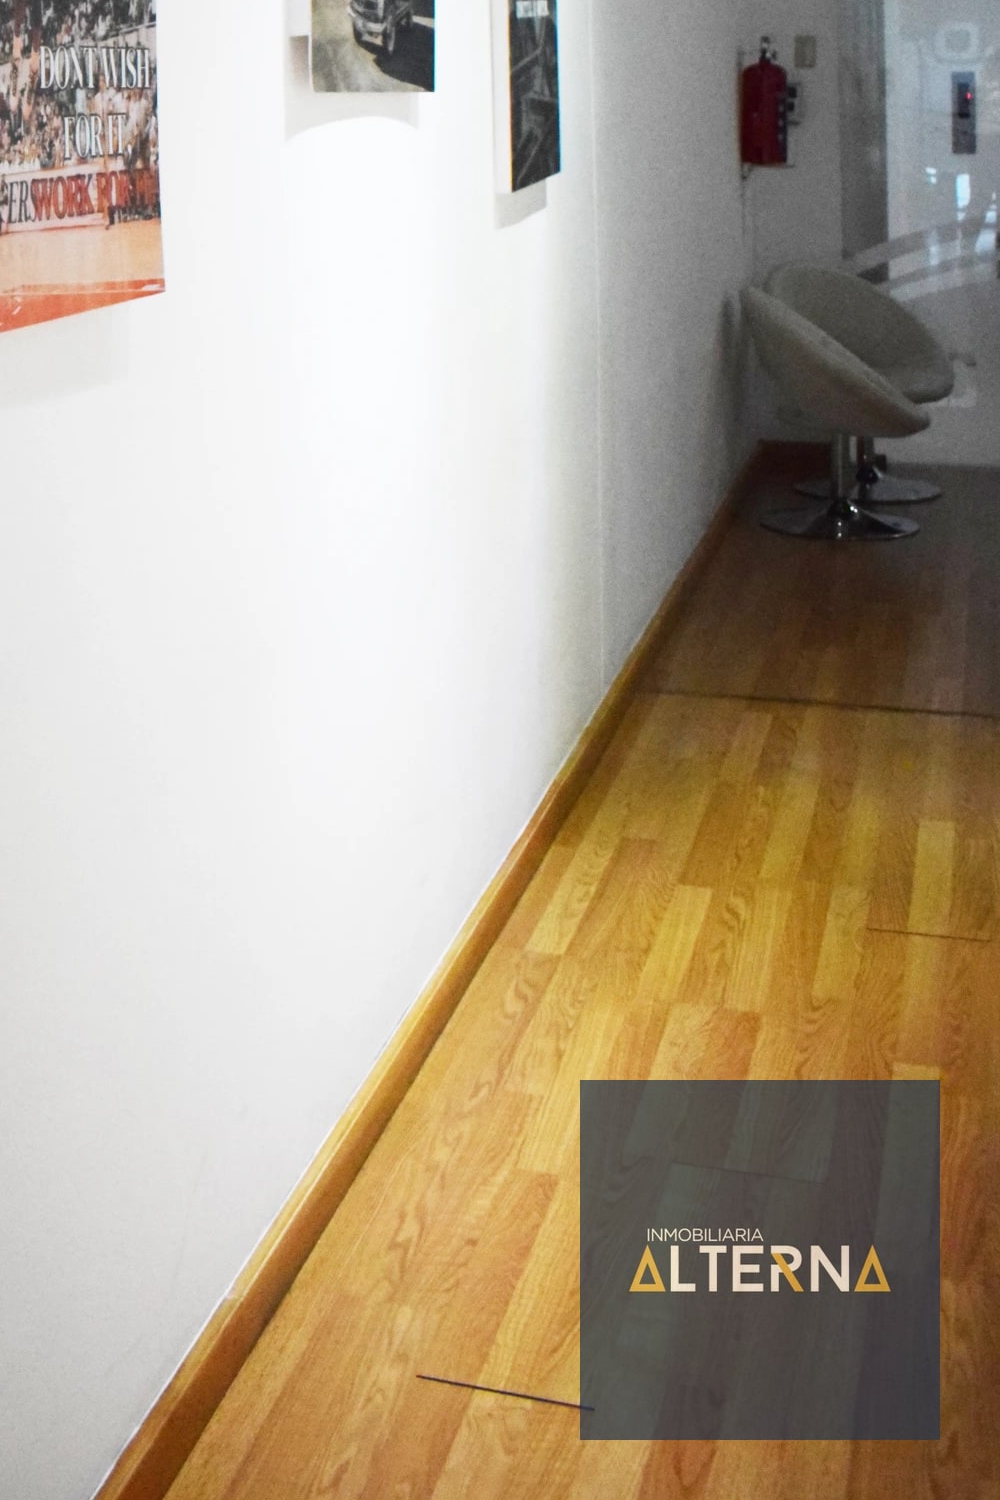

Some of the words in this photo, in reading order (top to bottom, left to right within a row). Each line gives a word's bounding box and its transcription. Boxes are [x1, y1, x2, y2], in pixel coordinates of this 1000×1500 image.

[101, 47, 150, 89] WISH
[64, 114, 103, 158] FOR
[32, 174, 95, 221] WORK
